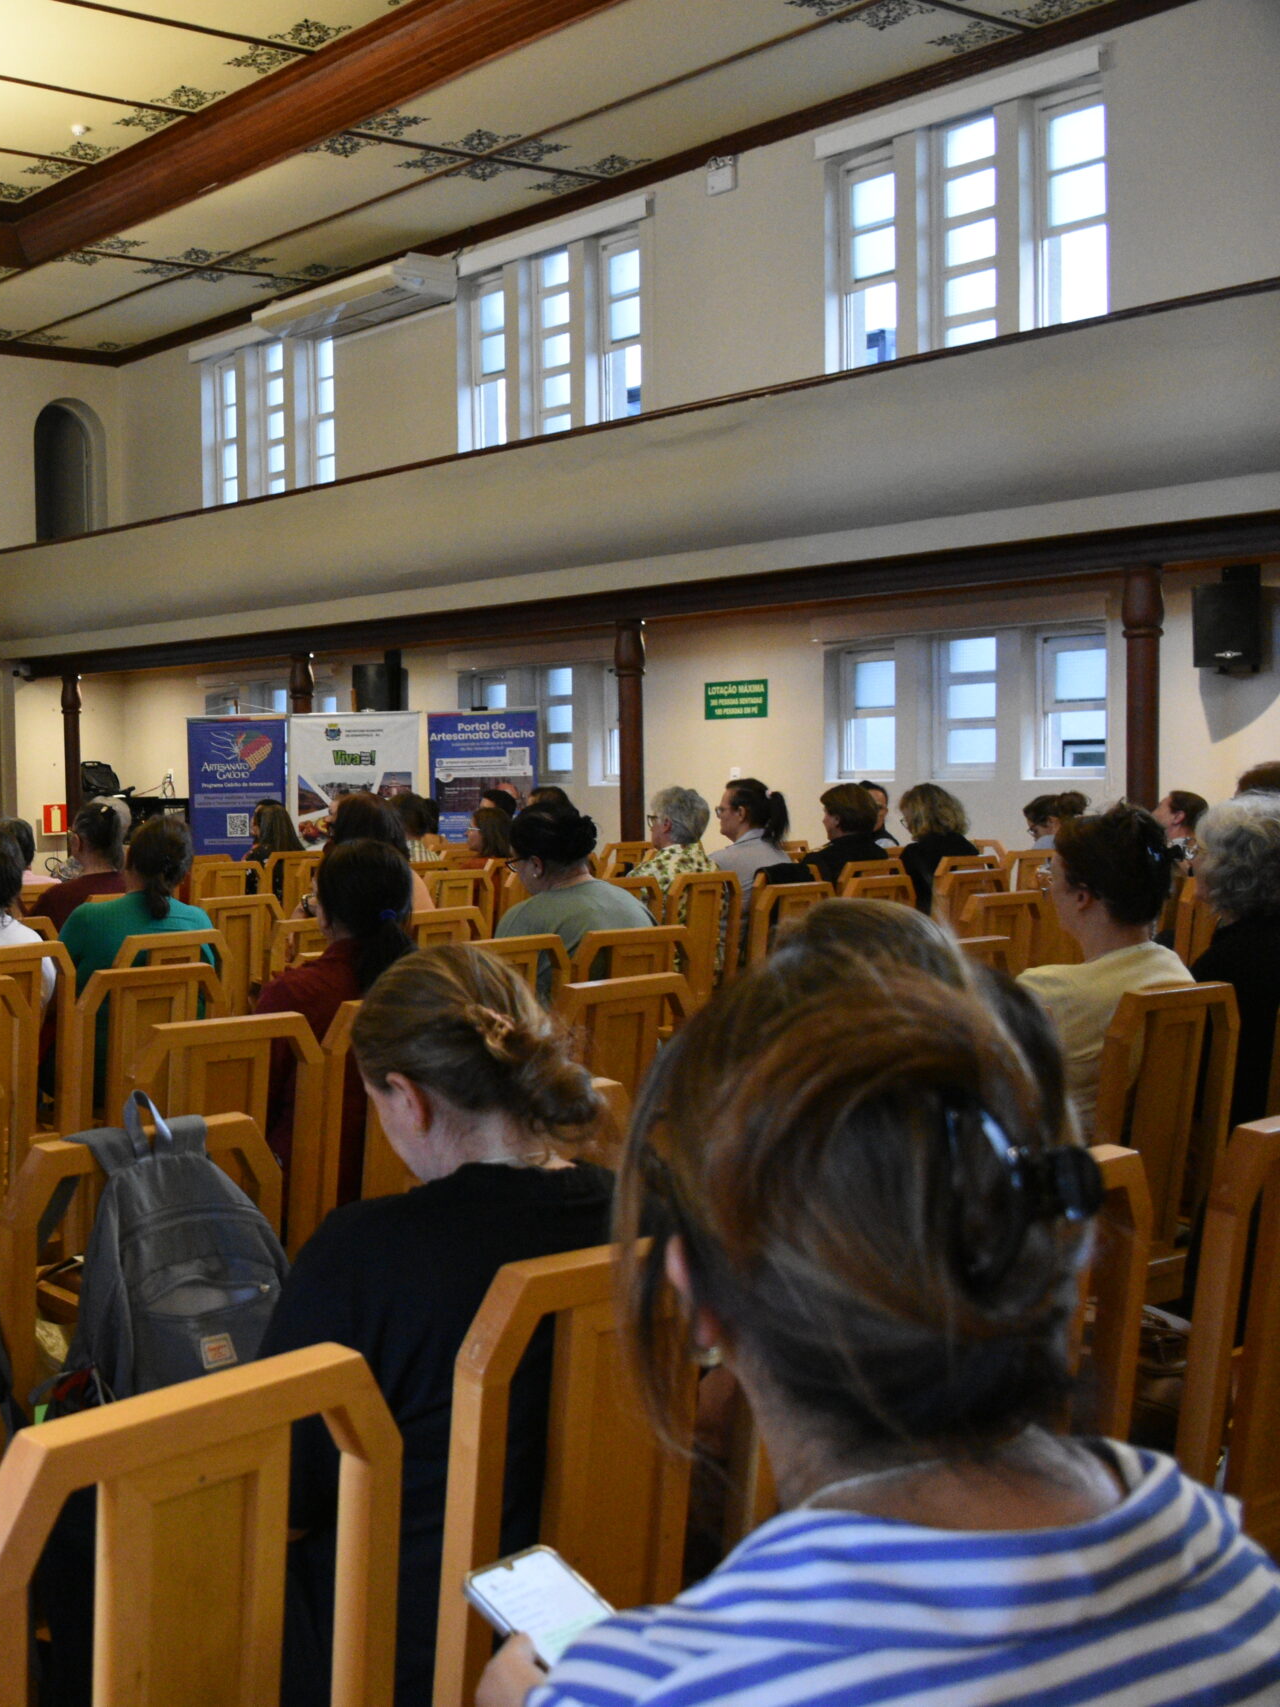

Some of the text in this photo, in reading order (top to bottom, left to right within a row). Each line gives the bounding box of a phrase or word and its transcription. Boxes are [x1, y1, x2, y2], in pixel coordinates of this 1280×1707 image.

[708, 682, 765, 696] LOTAÇÃO MÁXIMA
[457, 721, 506, 731] Portal do
[430, 729, 535, 741] Artesanato Gaúcho
[332, 750, 360, 766] Viva
[201, 762, 249, 772] ARTESANATO
[216, 770, 250, 780] GAÚCHO
